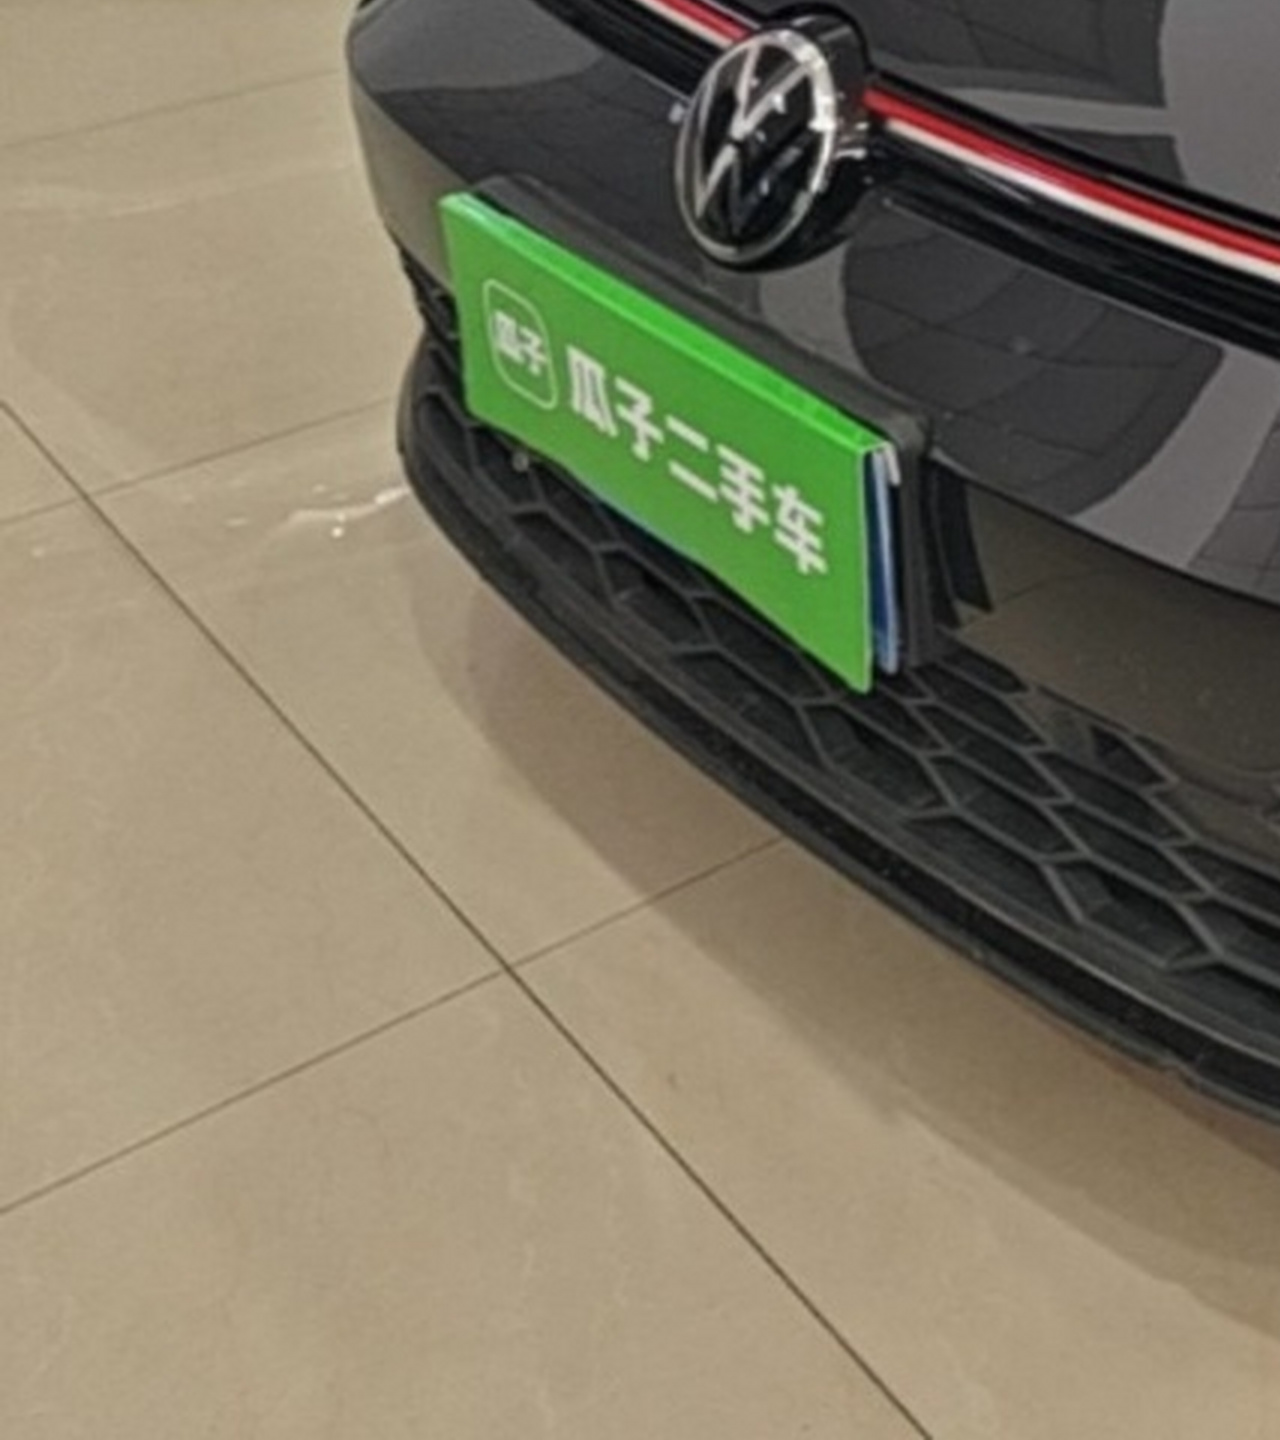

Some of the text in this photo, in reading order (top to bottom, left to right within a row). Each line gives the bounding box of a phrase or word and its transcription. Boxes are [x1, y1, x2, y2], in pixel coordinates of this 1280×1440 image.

[565, 344, 828, 575] 瓜子二手车
